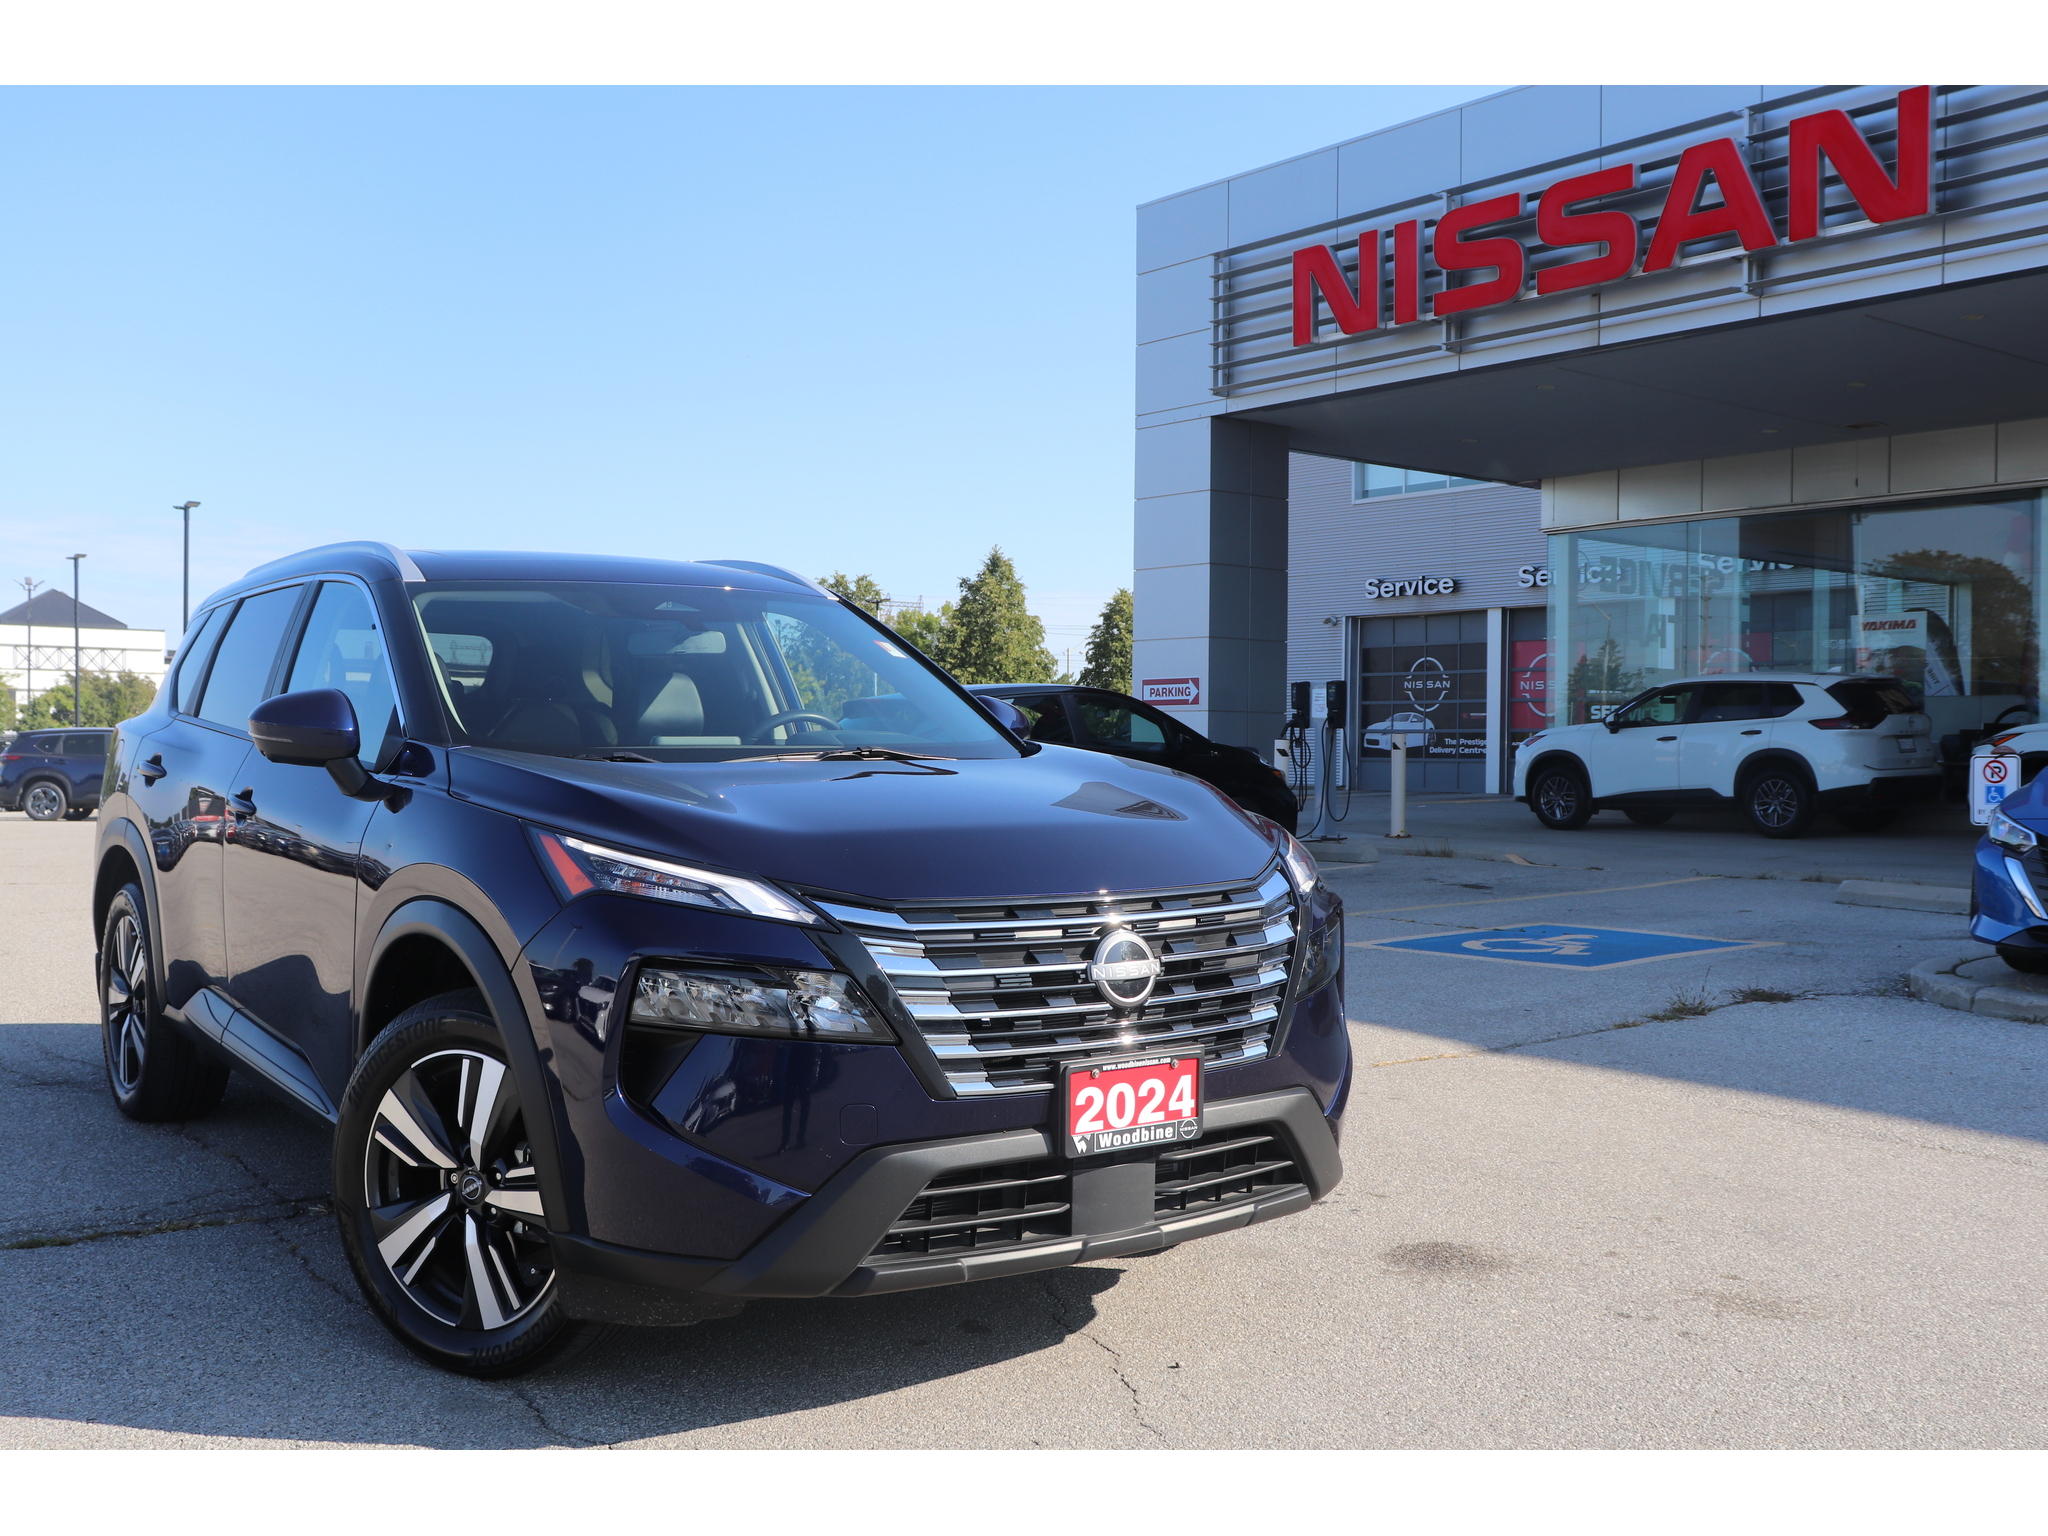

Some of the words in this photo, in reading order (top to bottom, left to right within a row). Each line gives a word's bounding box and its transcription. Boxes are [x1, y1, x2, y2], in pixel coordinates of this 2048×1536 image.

[1292, 86, 1930, 347] NISSAN
[1364, 575, 1454, 600] Service
[1861, 619, 1917, 631] YAKIMA
[1150, 686, 1191, 697] PARKING
[1404, 680, 1451, 689] NISSAN
[1520, 681, 1556, 690] NISS
[1429, 746, 1457, 755] Delivery
[1093, 959, 1161, 981] NISSAN
[1074, 1074, 1195, 1134] 2024
[1099, 1123, 1174, 1149] Woodbine
